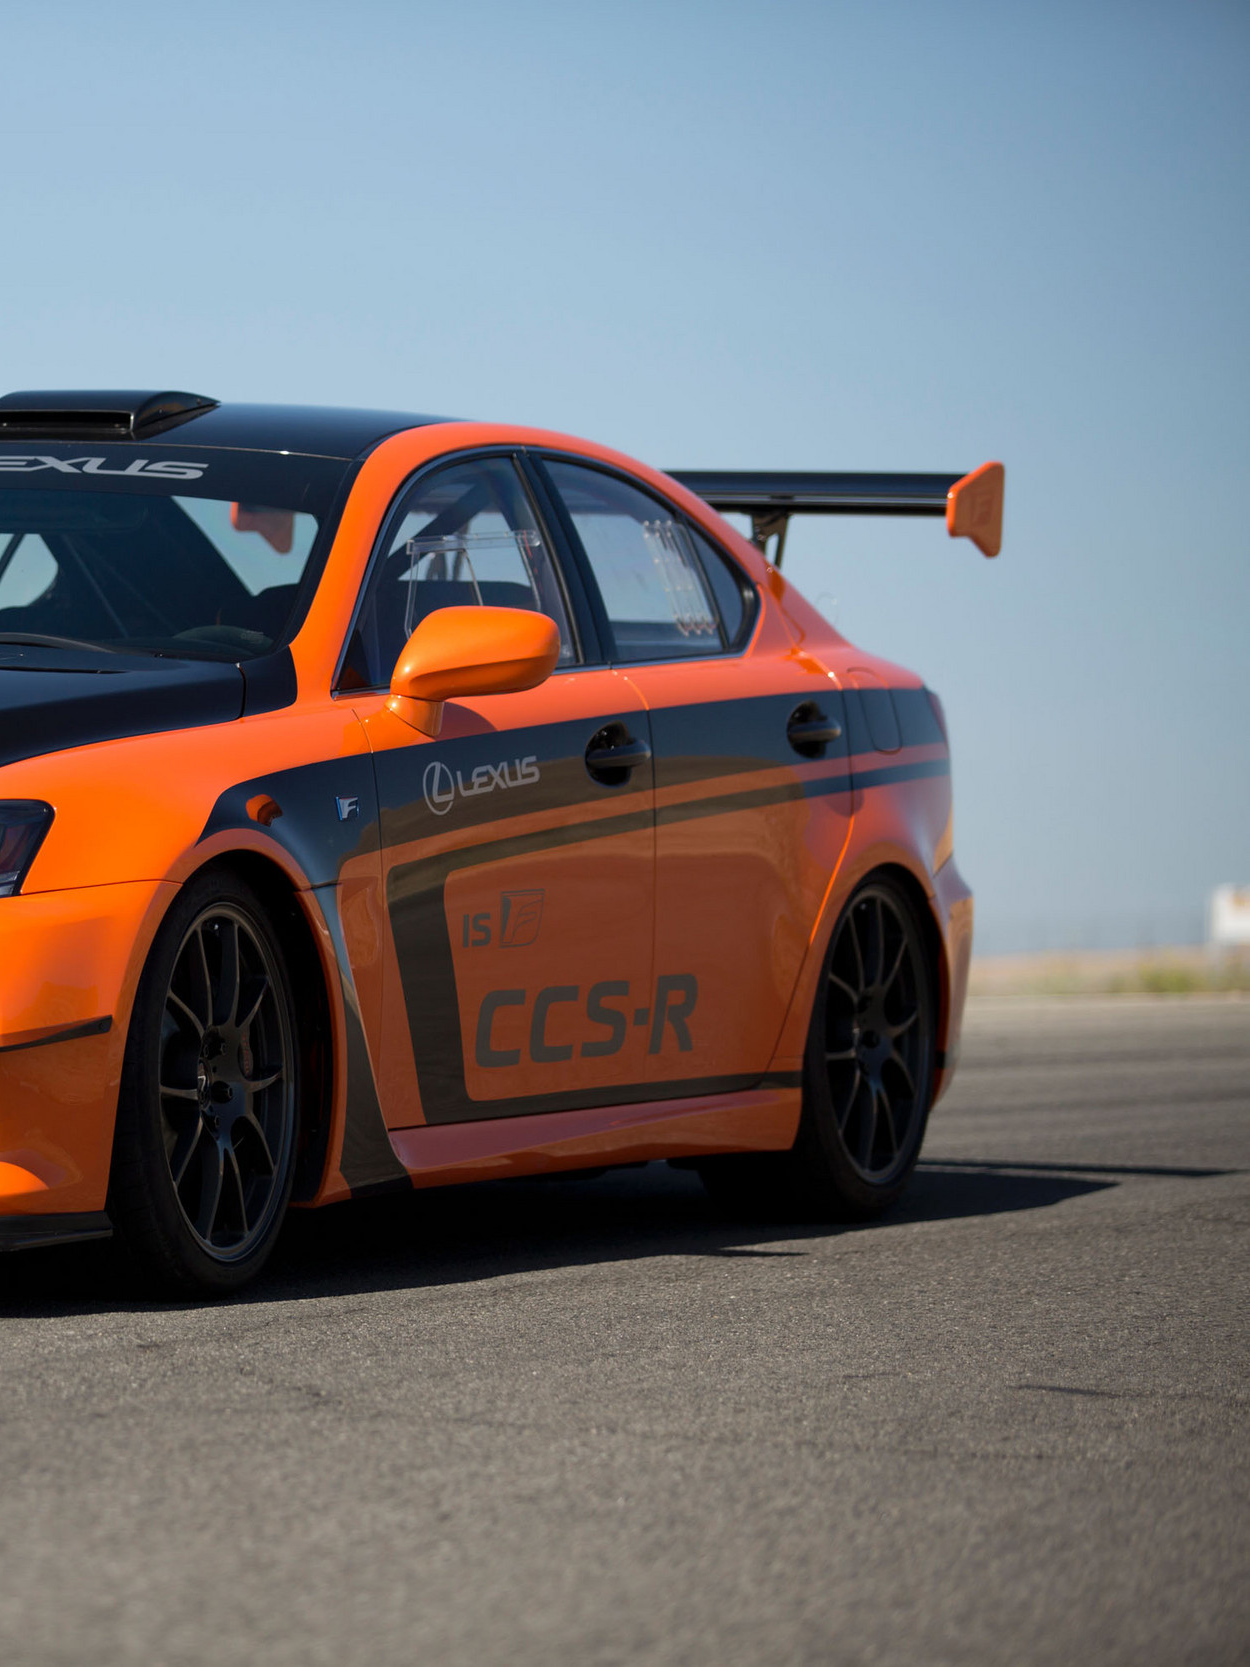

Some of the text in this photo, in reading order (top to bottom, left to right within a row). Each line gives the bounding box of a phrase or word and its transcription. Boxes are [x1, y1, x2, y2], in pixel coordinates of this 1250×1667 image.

[456, 755, 540, 797] LEXUS
[462, 912, 492, 948] IS
[475, 973, 699, 1068] CCS-R
